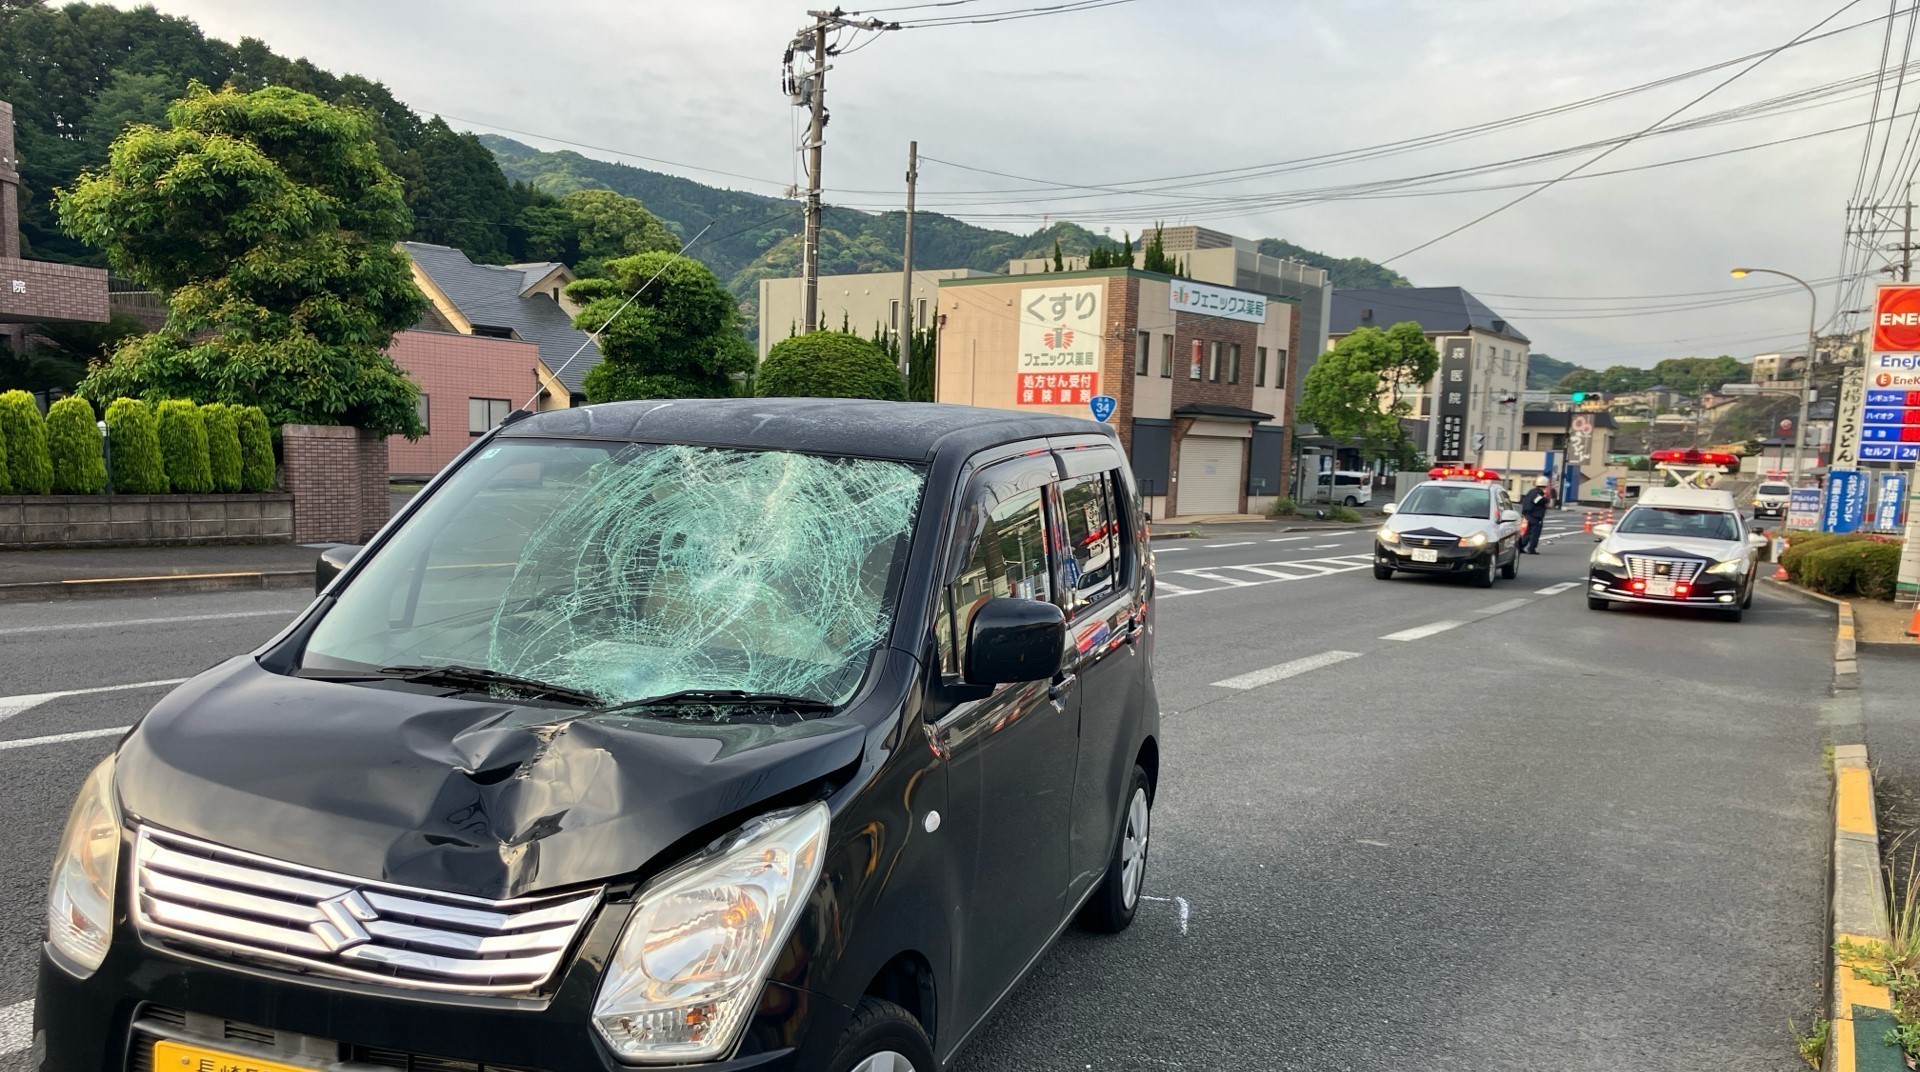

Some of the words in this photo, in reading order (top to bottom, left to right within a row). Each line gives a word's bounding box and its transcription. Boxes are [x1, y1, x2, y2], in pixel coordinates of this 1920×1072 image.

[1026, 291, 1097, 321] くすり
[1191, 290, 1264, 317] フェニックス薬局
[1880, 313, 1920, 326] ENE
[1024, 351, 1094, 366] フェニックス薬局
[1023, 375, 1092, 388] 処方せん受付
[1022, 389, 1092, 403] 保険調剤
[1868, 394, 1903, 402] レギュラー
[1096, 402, 1110, 413] 34
[1866, 412, 1895, 420] ハイオク
[1864, 447, 1892, 456] セルフ
[1902, 448, 1917, 457] 24
